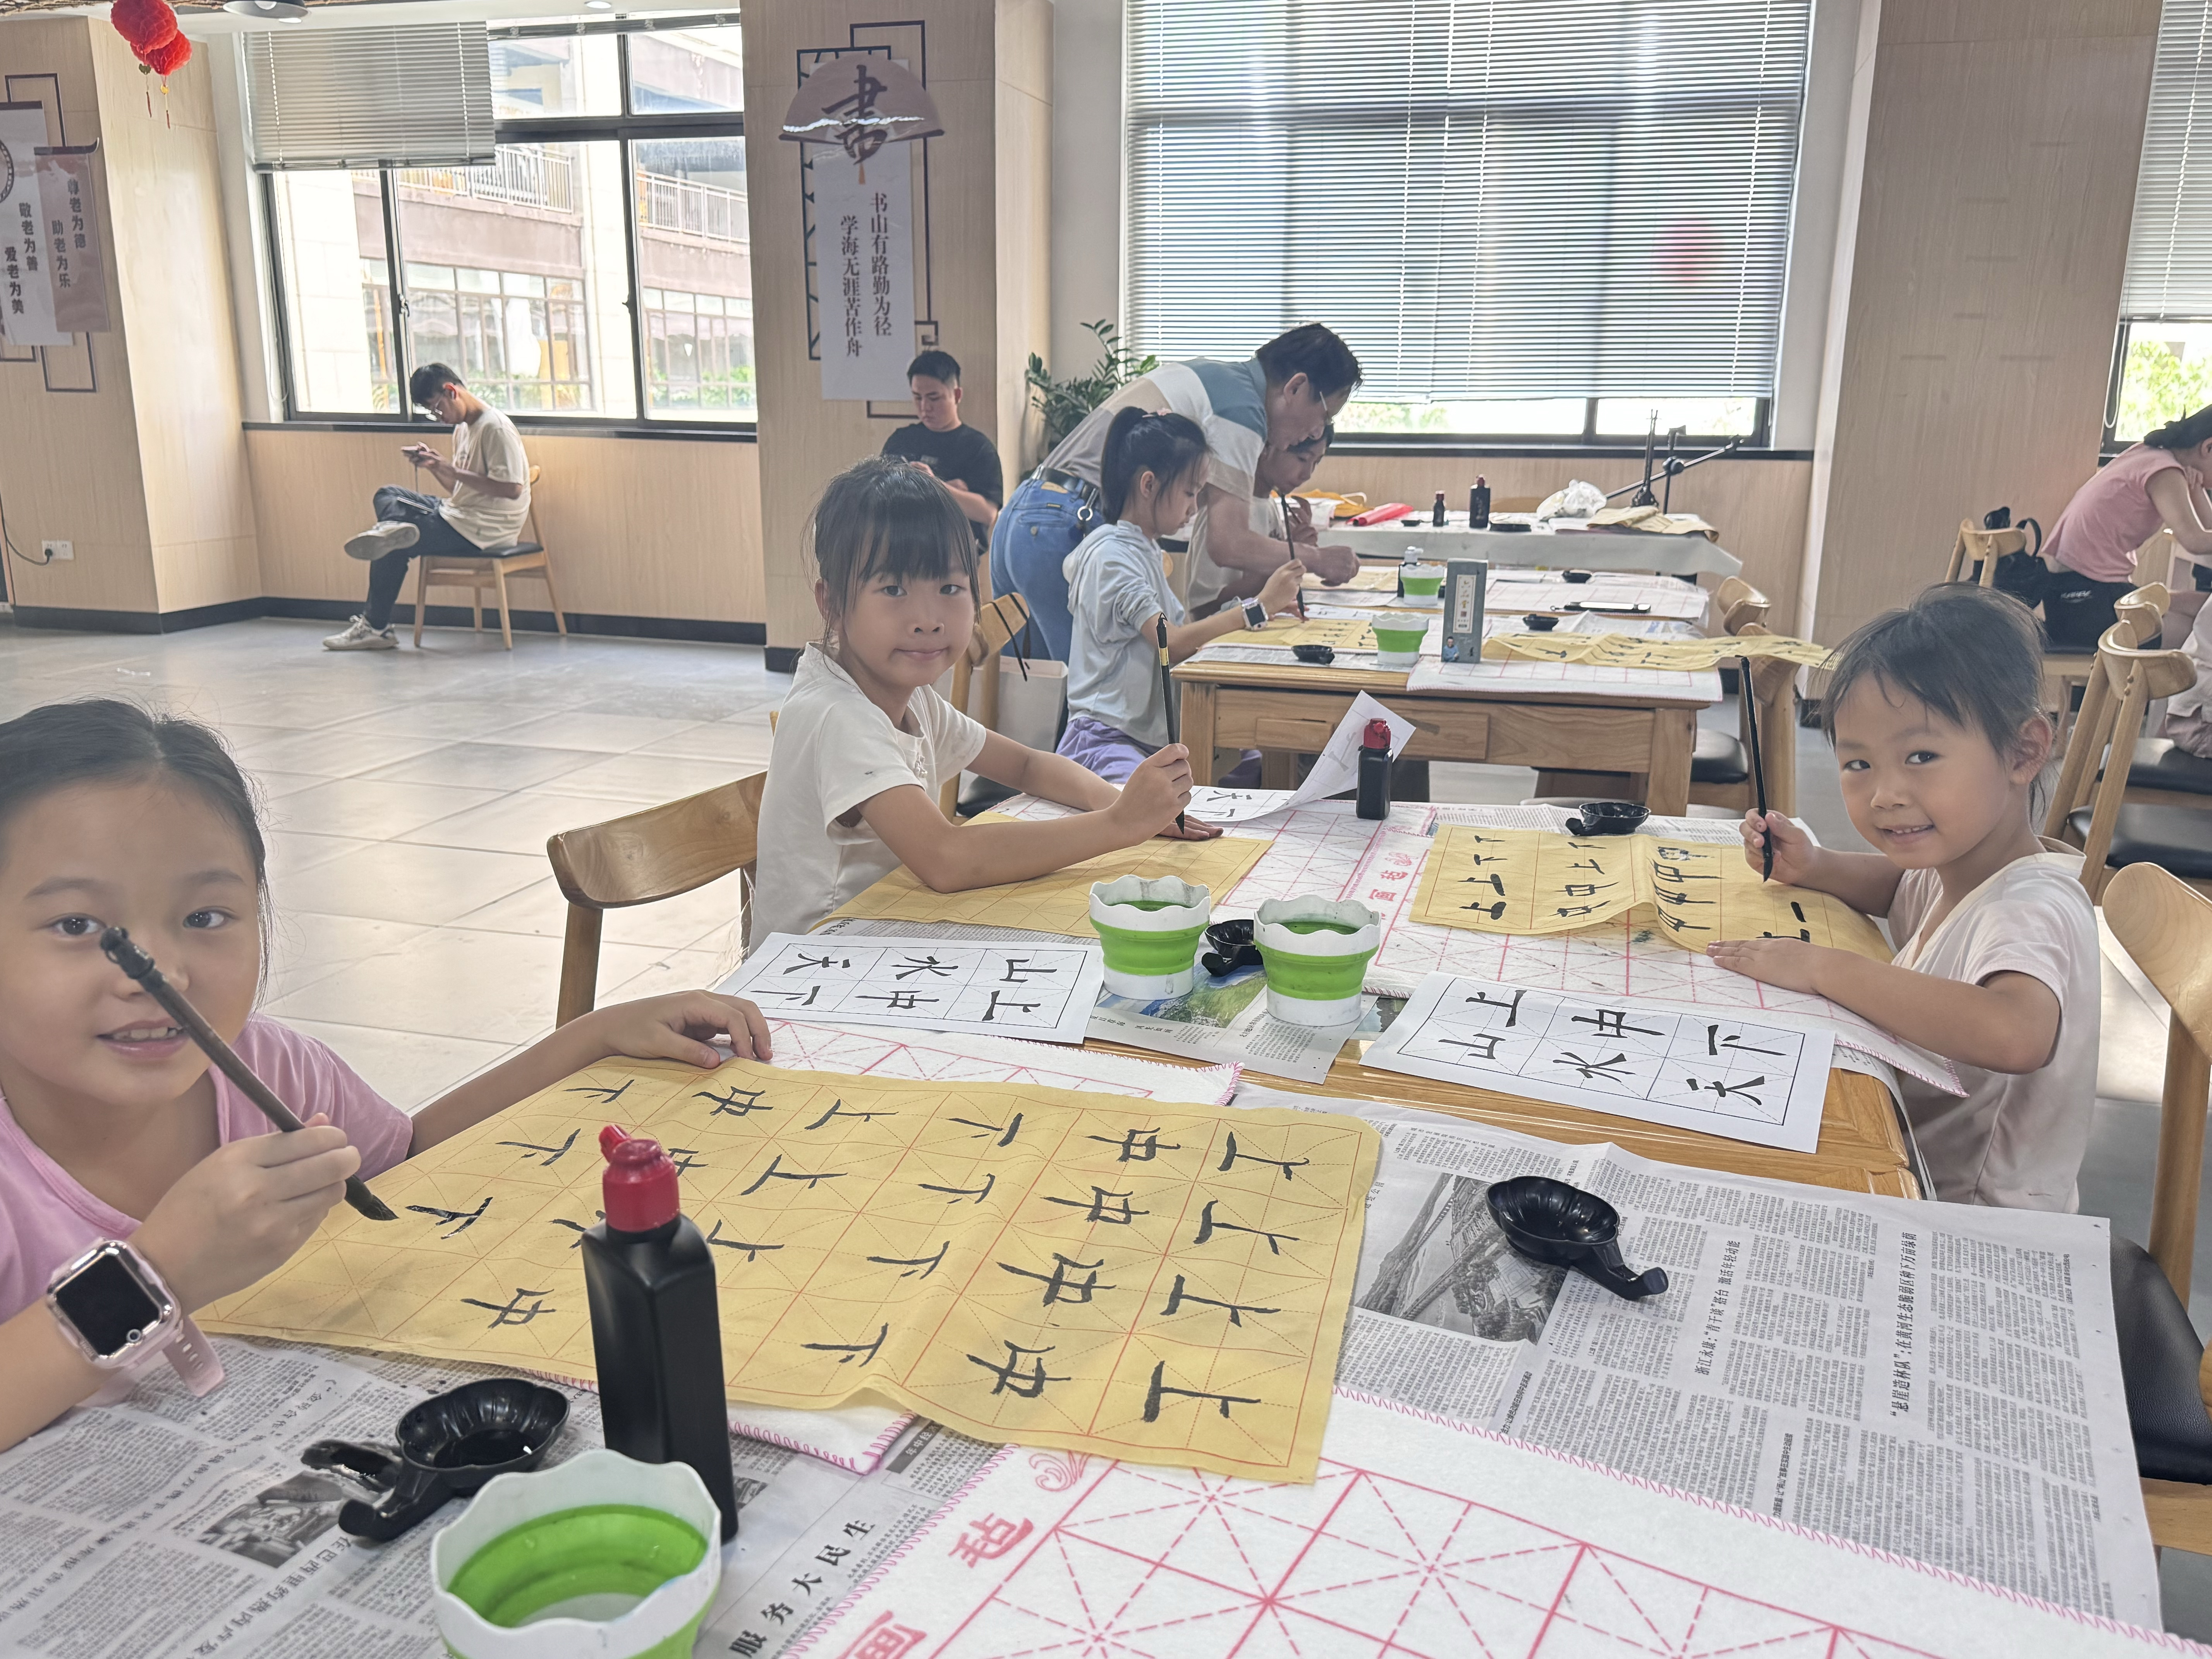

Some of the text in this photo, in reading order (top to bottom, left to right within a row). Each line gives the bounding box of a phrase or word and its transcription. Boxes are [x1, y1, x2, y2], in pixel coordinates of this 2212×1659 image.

[19, 202, 39, 271] 敬老为善
[67, 179, 86, 250] 尊老为德
[4, 246, 24, 315] 爱老为美
[51, 219, 71, 289] 助老为乐
[840, 215, 864, 358] 学海无涯苦作舟
[869, 192, 892, 338] 书山有路勤为径
[783, 953, 1057, 982] 天 水 山
[746, 986, 1041, 1021] 下 中 上
[1466, 990, 1786, 1055] 上 中 下
[1439, 1034, 1764, 1105] 山 水 天
[1717, 1240, 1741, 1286] 激活年轻动能
[727, 1522, 875, 1659] 服务大民生
